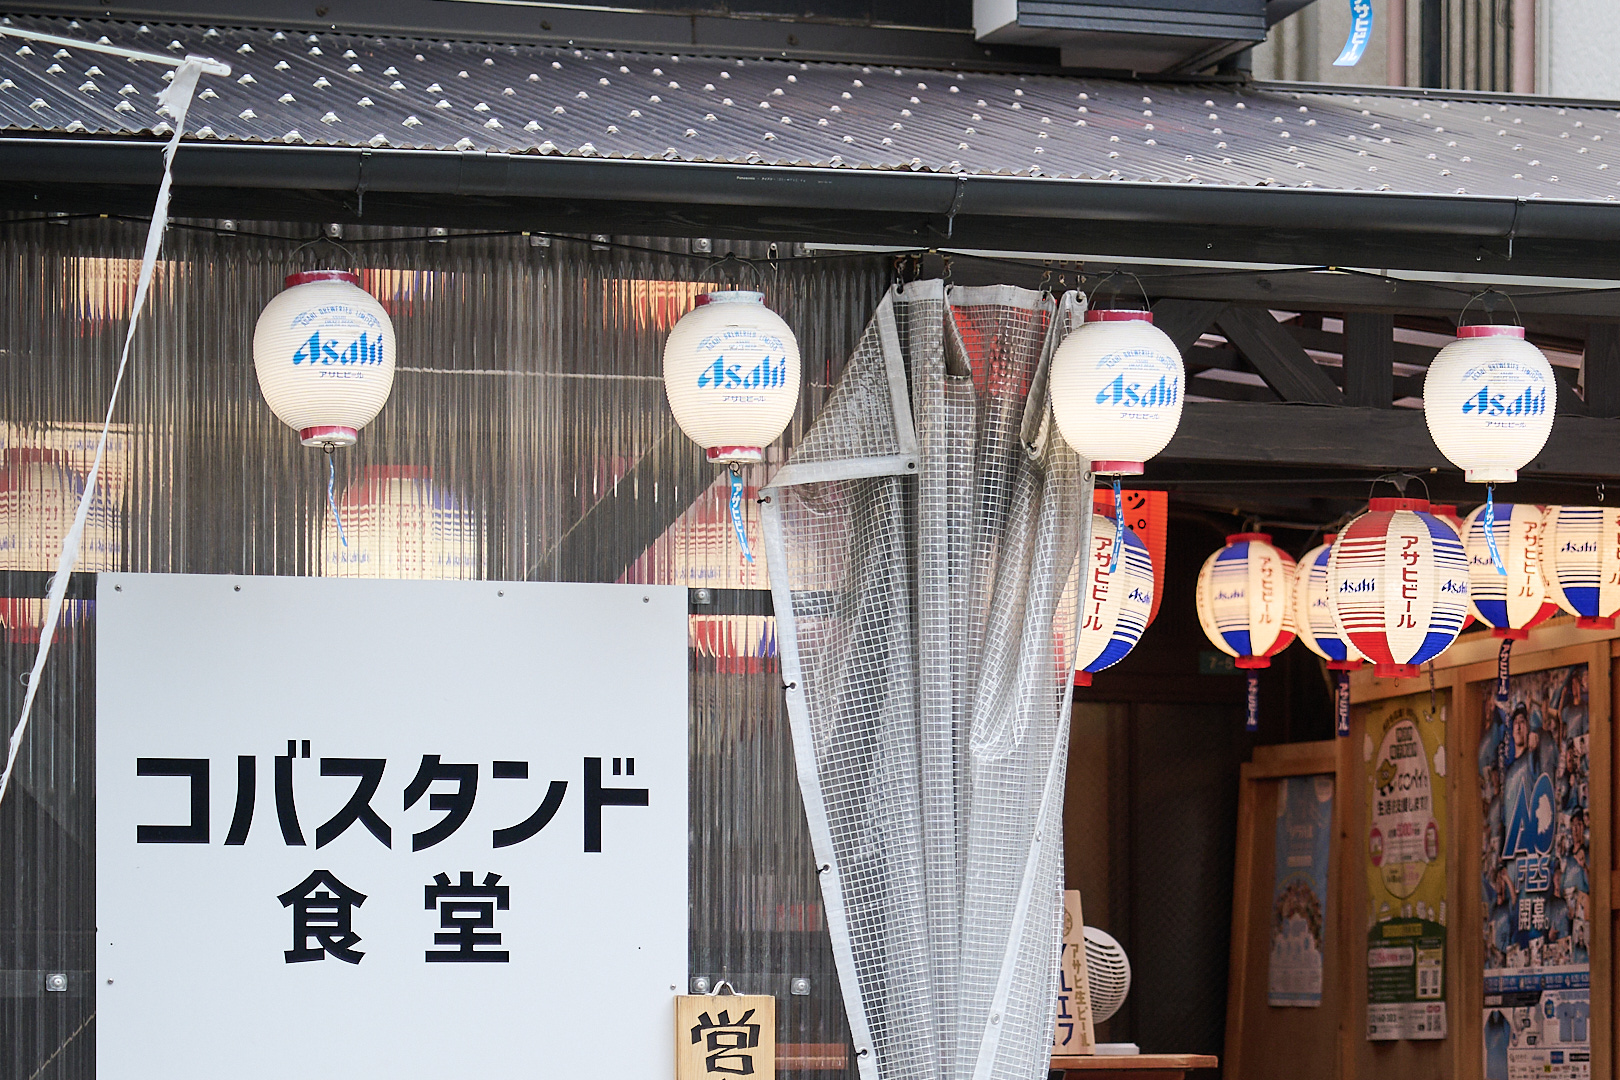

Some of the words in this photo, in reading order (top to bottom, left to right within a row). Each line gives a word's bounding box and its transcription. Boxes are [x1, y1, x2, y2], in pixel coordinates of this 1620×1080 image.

[1340, 0, 1369, 61] サヒビール
[292, 330, 383, 365] Asahi
[319, 371, 364, 379] アサヒビール
[697, 354, 785, 389] Asahi
[1095, 373, 1178, 408] Asahi
[1120, 412, 1160, 420] アサヒビール
[1461, 386, 1546, 417] Asahi
[731, 482, 750, 555] アサヒビール
[1518, 521, 1538, 598] アサヒビール
[1561, 541, 1598, 553] Asahi
[1083, 536, 1113, 631] アサヒビール
[1214, 588, 1246, 601] Asahi
[1258, 556, 1273, 624] アサヒビール
[1340, 578, 1375, 593] Asahi
[1397, 535, 1420, 629] アサヒビール
[136, 740, 650, 853] コバスタンド
[1502, 772, 1555, 859] AO
[1515, 855, 1551, 893] FES
[276, 869, 510, 965] 食堂
[1518, 898, 1549, 931] 開幕。
[1070, 943, 1090, 1047] アサヒ生ビール
